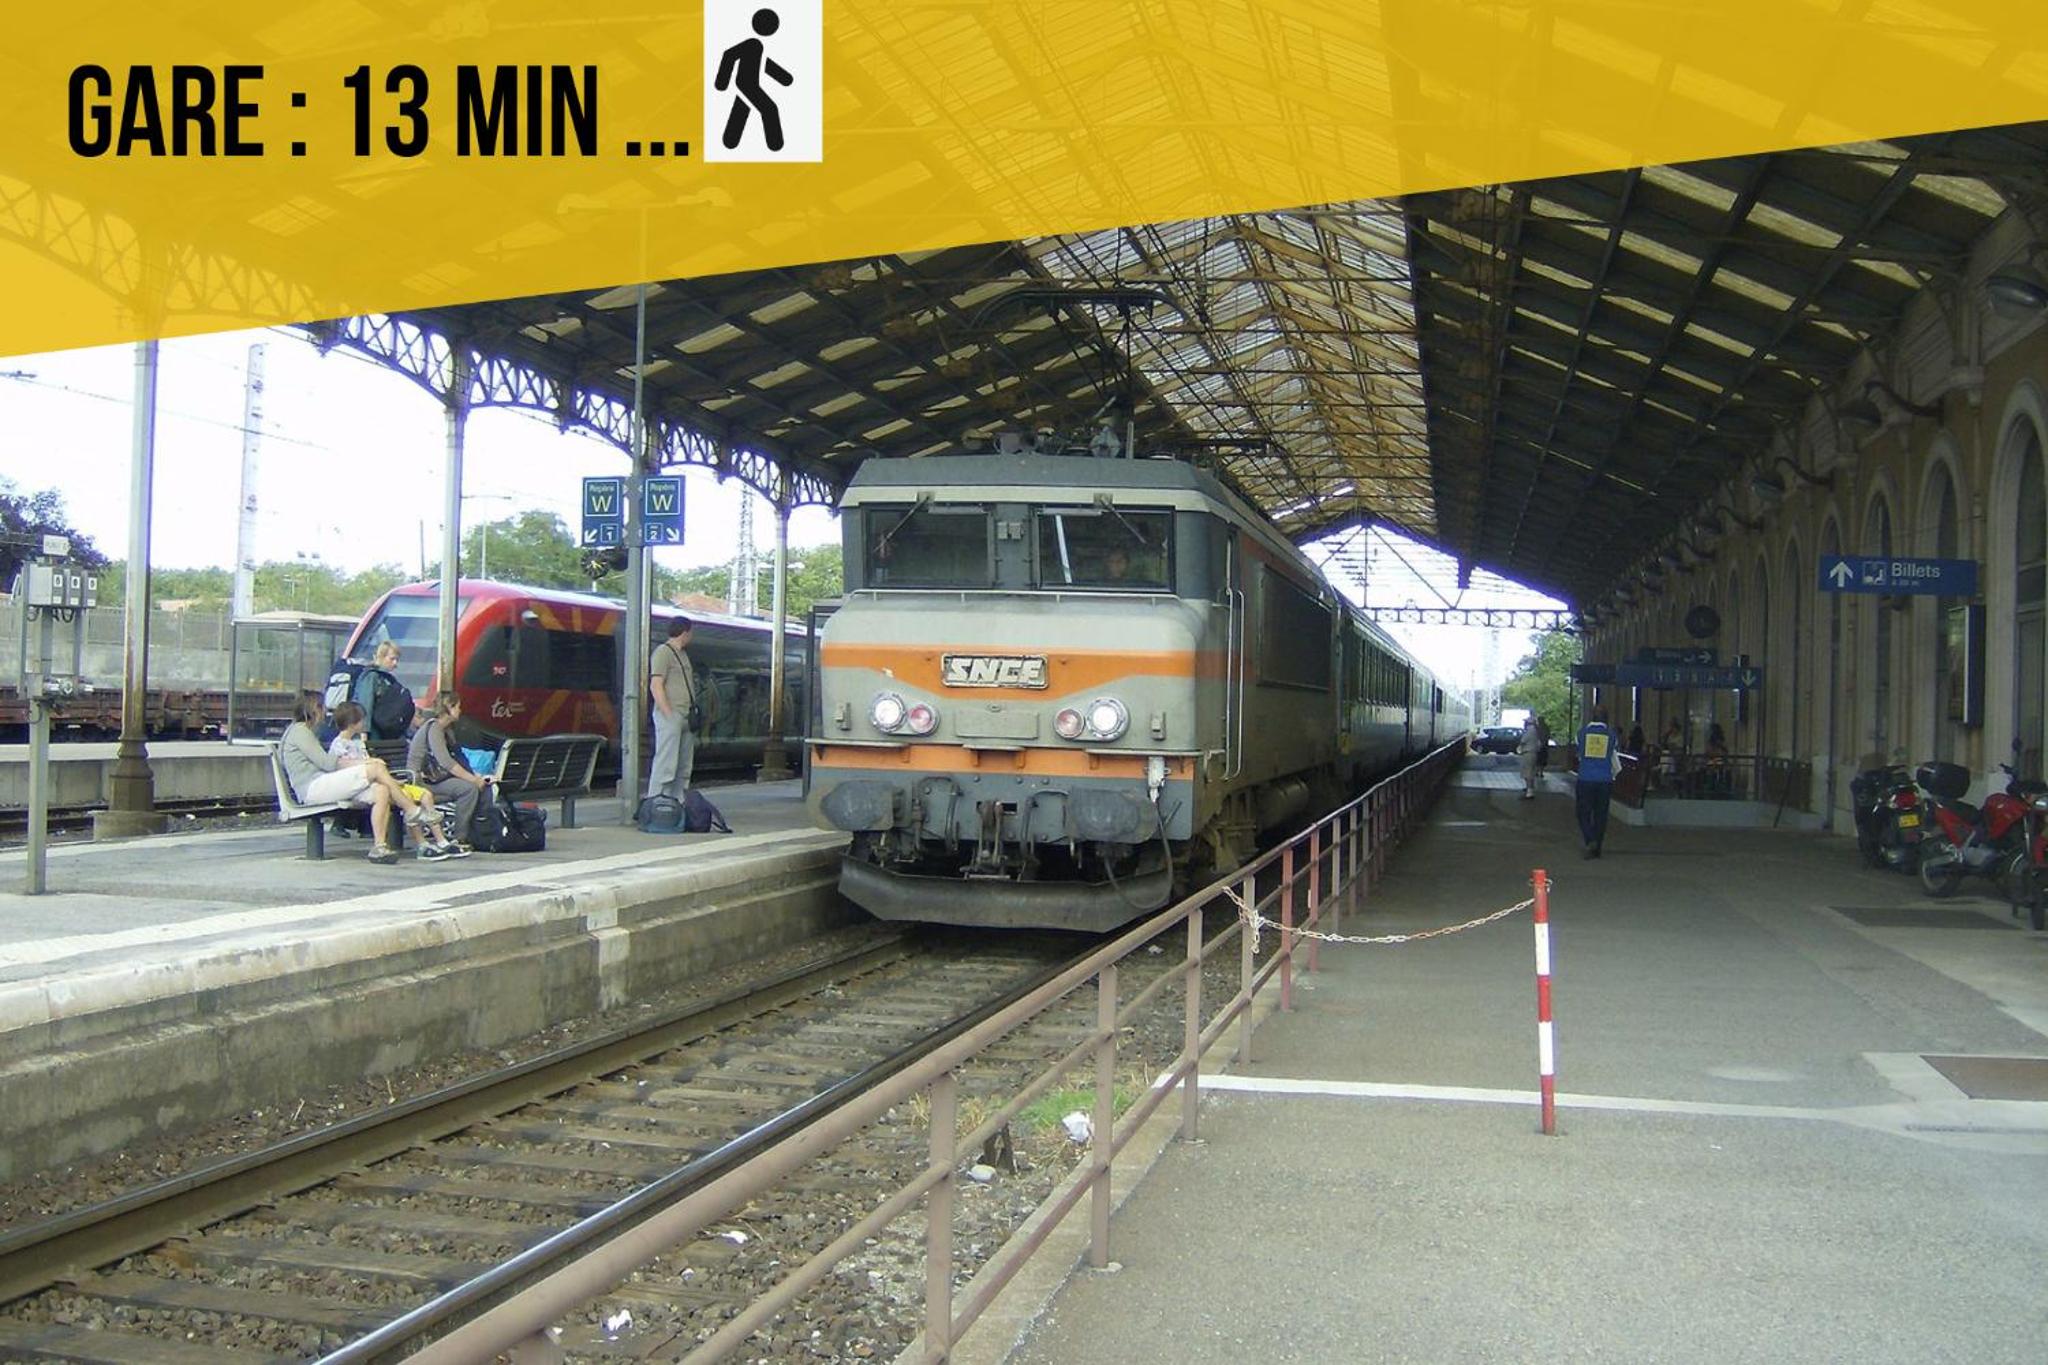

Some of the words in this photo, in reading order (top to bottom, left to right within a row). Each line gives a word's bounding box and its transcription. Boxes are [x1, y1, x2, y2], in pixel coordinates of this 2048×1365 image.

[591, 495, 612, 512] W
[652, 494, 673, 511] W
[650, 530, 657, 540] 2
[1891, 562, 1941, 578] Billets
[948, 658, 1043, 684] SNCF
